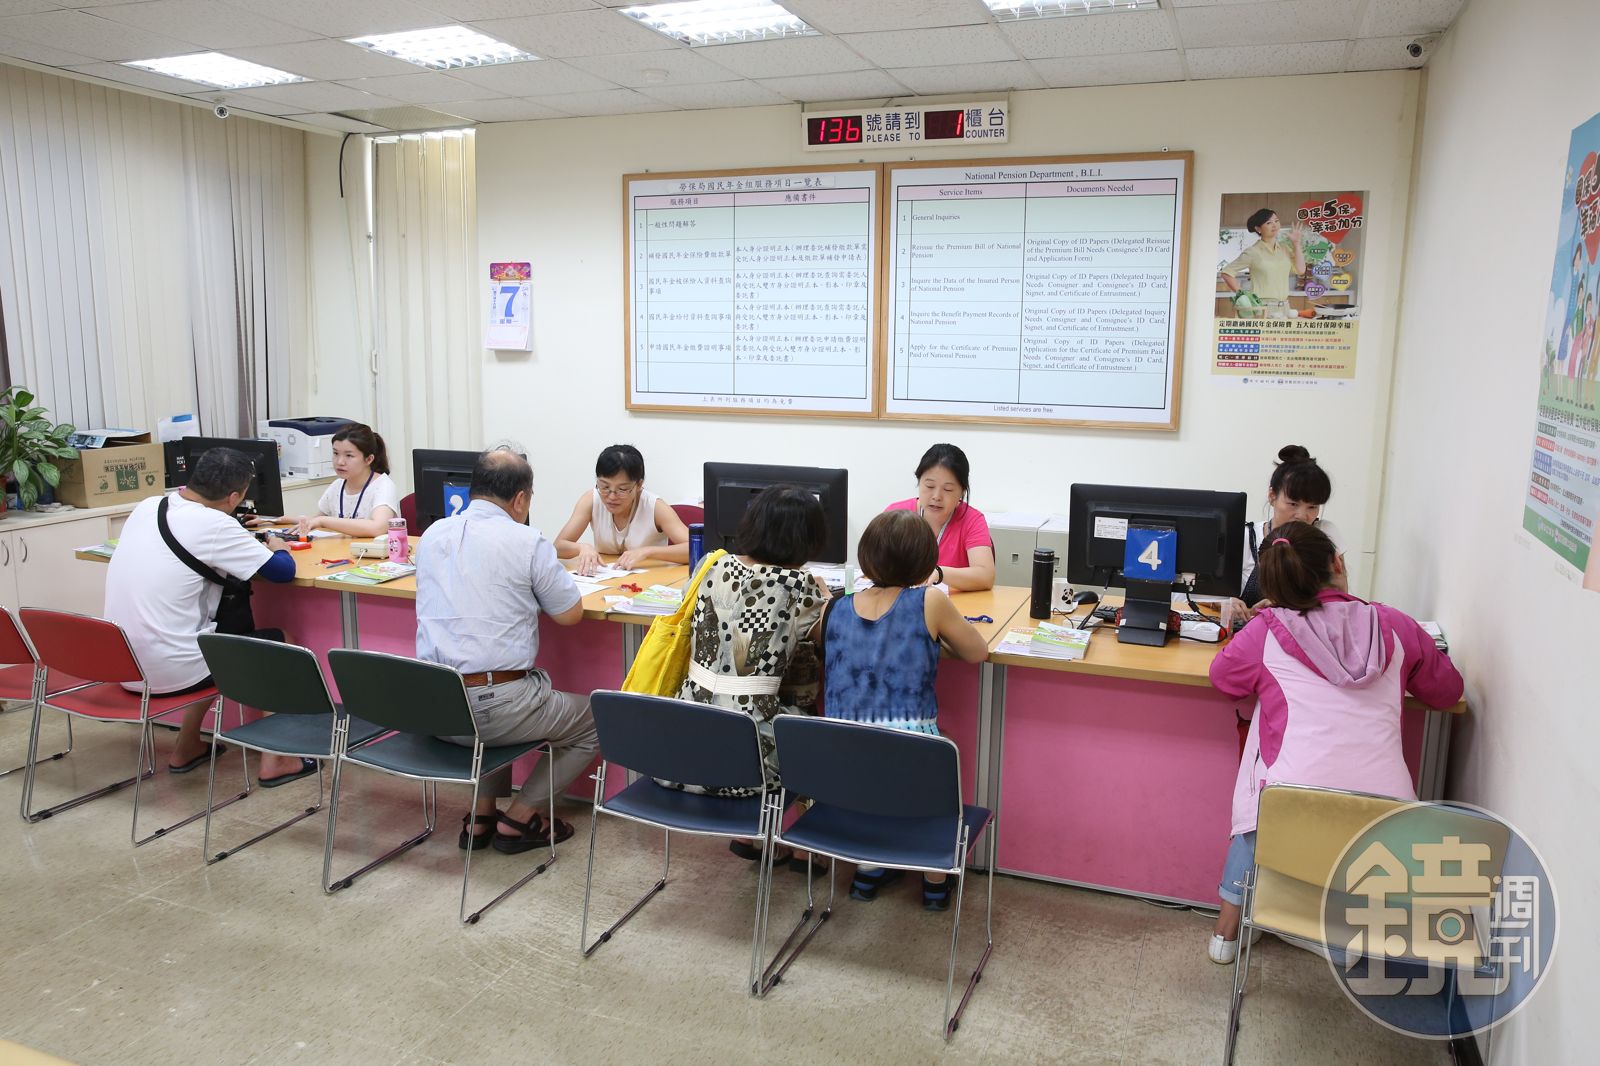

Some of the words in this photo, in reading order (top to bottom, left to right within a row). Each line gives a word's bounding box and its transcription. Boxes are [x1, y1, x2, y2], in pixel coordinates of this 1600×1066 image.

[866, 112, 920, 131] 號請到
[956, 112, 962, 136] 1
[966, 108, 1004, 127] 櫃台
[820, 118, 859, 142] 136
[866, 134, 900, 142] PLEASE
[966, 129, 1004, 138] COUNTER
[1030, 170, 1074, 180] Department
[1309, 216, 1363, 233] 幸福加分
[500, 286, 520, 317] 7
[1138, 540, 1161, 571] 4
